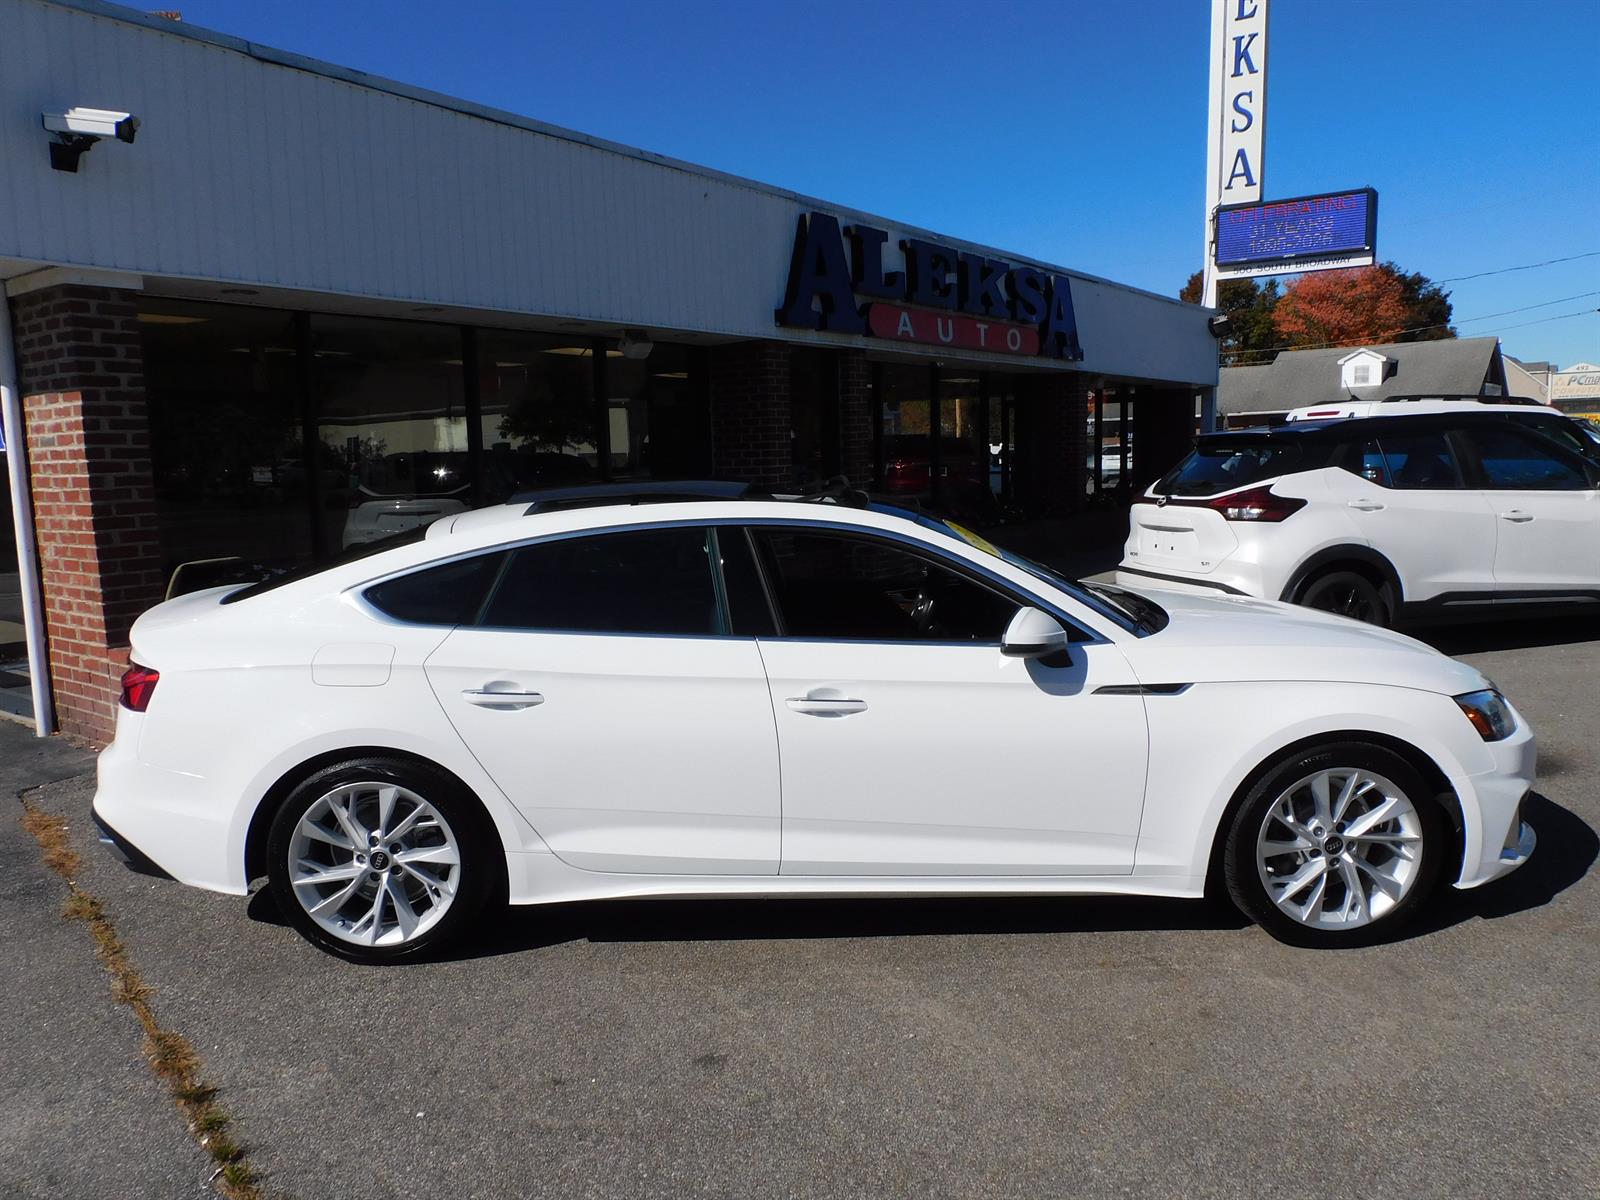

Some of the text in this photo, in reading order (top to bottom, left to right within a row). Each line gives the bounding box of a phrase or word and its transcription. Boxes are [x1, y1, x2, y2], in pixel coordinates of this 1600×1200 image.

[1249, 215, 1334, 239] 31 YEARS
[1233, 255, 1352, 275] 500 SOUTH BROADWAY
[774, 211, 1084, 361] ALEKSA
[897, 311, 1022, 351] AUTO
